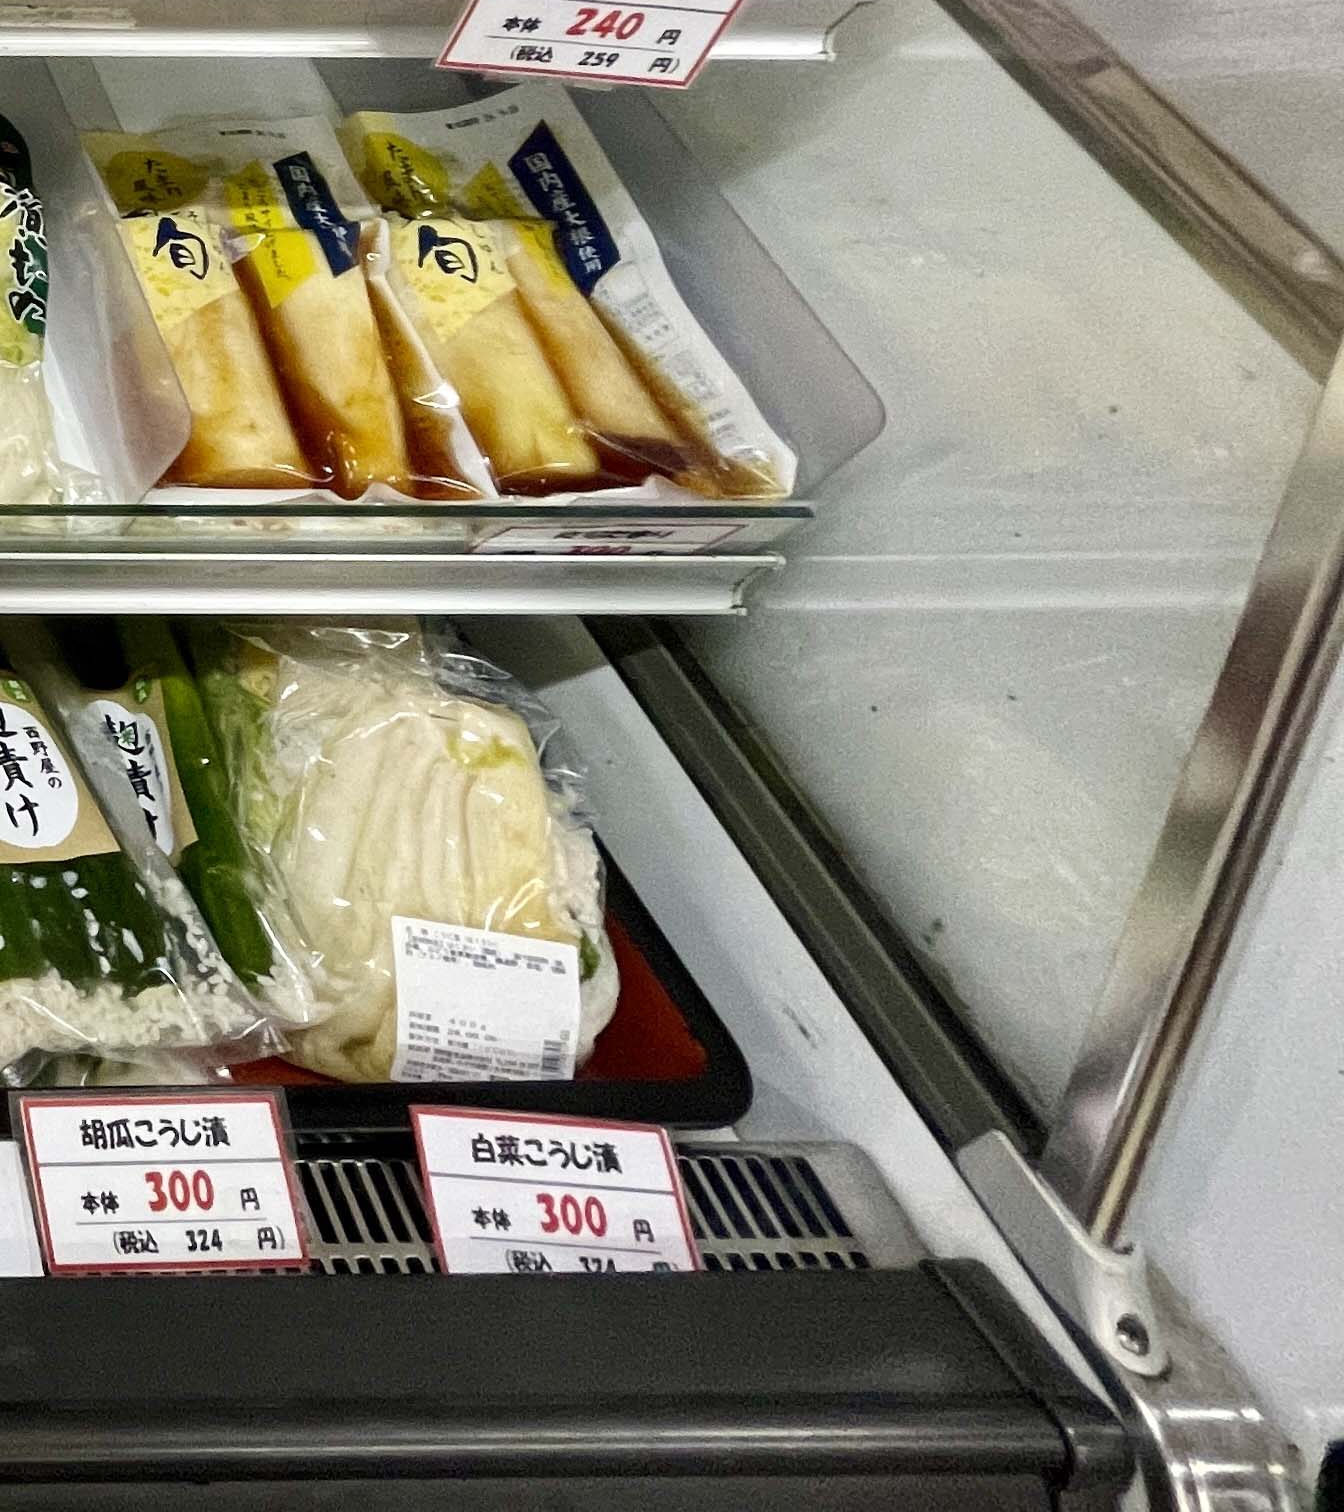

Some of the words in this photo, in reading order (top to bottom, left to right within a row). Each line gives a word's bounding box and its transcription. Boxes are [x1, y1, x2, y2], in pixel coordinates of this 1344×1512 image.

[501, 15, 543, 34] 本体
[564, 7, 647, 42] 240
[655, 28, 683, 47] 円
[577, 49, 621, 69] 259
[647, 56, 681, 74] 円)
[151, 216, 210, 281] 旬
[417, 224, 479, 285] 旬
[22, 725, 65, 790] 西野屋の
[79, 1116, 231, 1150] 胡瓜こうじ漬
[471, 1133, 624, 1175] 白菜こうじ漬
[80, 1191, 120, 1215] 本体
[144, 1169, 215, 1213] 300
[240, 1186, 261, 1211] 円
[471, 1206, 513, 1231] 本体
[535, 1192, 609, 1238] 300
[632, 1218, 656, 1243] 円
[112, 1230, 160, 1255] (税込
[184, 1229, 223, 1252] 324
[257, 1225, 286, 1251] 円)
